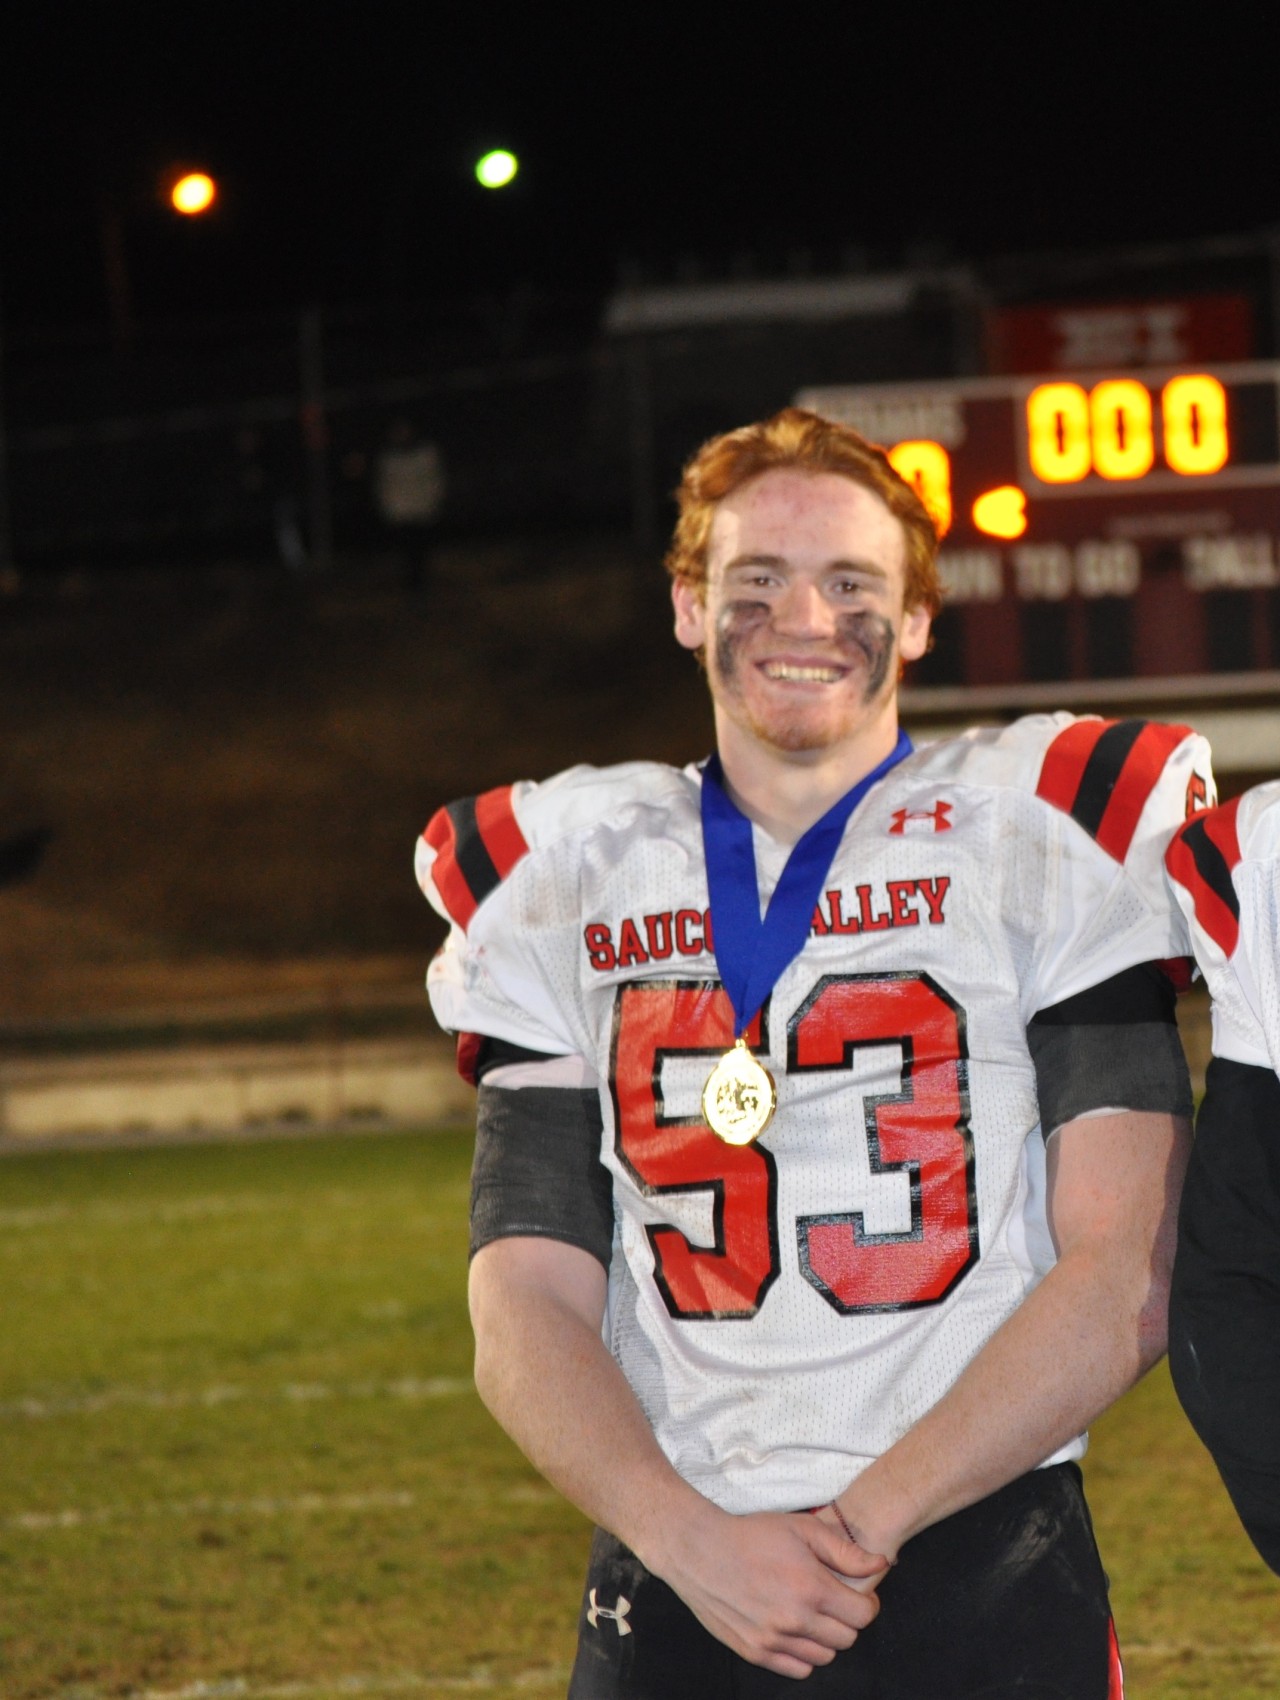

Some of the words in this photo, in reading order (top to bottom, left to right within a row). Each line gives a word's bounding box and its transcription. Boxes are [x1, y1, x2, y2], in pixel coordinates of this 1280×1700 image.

[584, 908, 716, 971] SAUC
[806, 876, 951, 938] ALLEY
[607, 970, 981, 1321] 53
